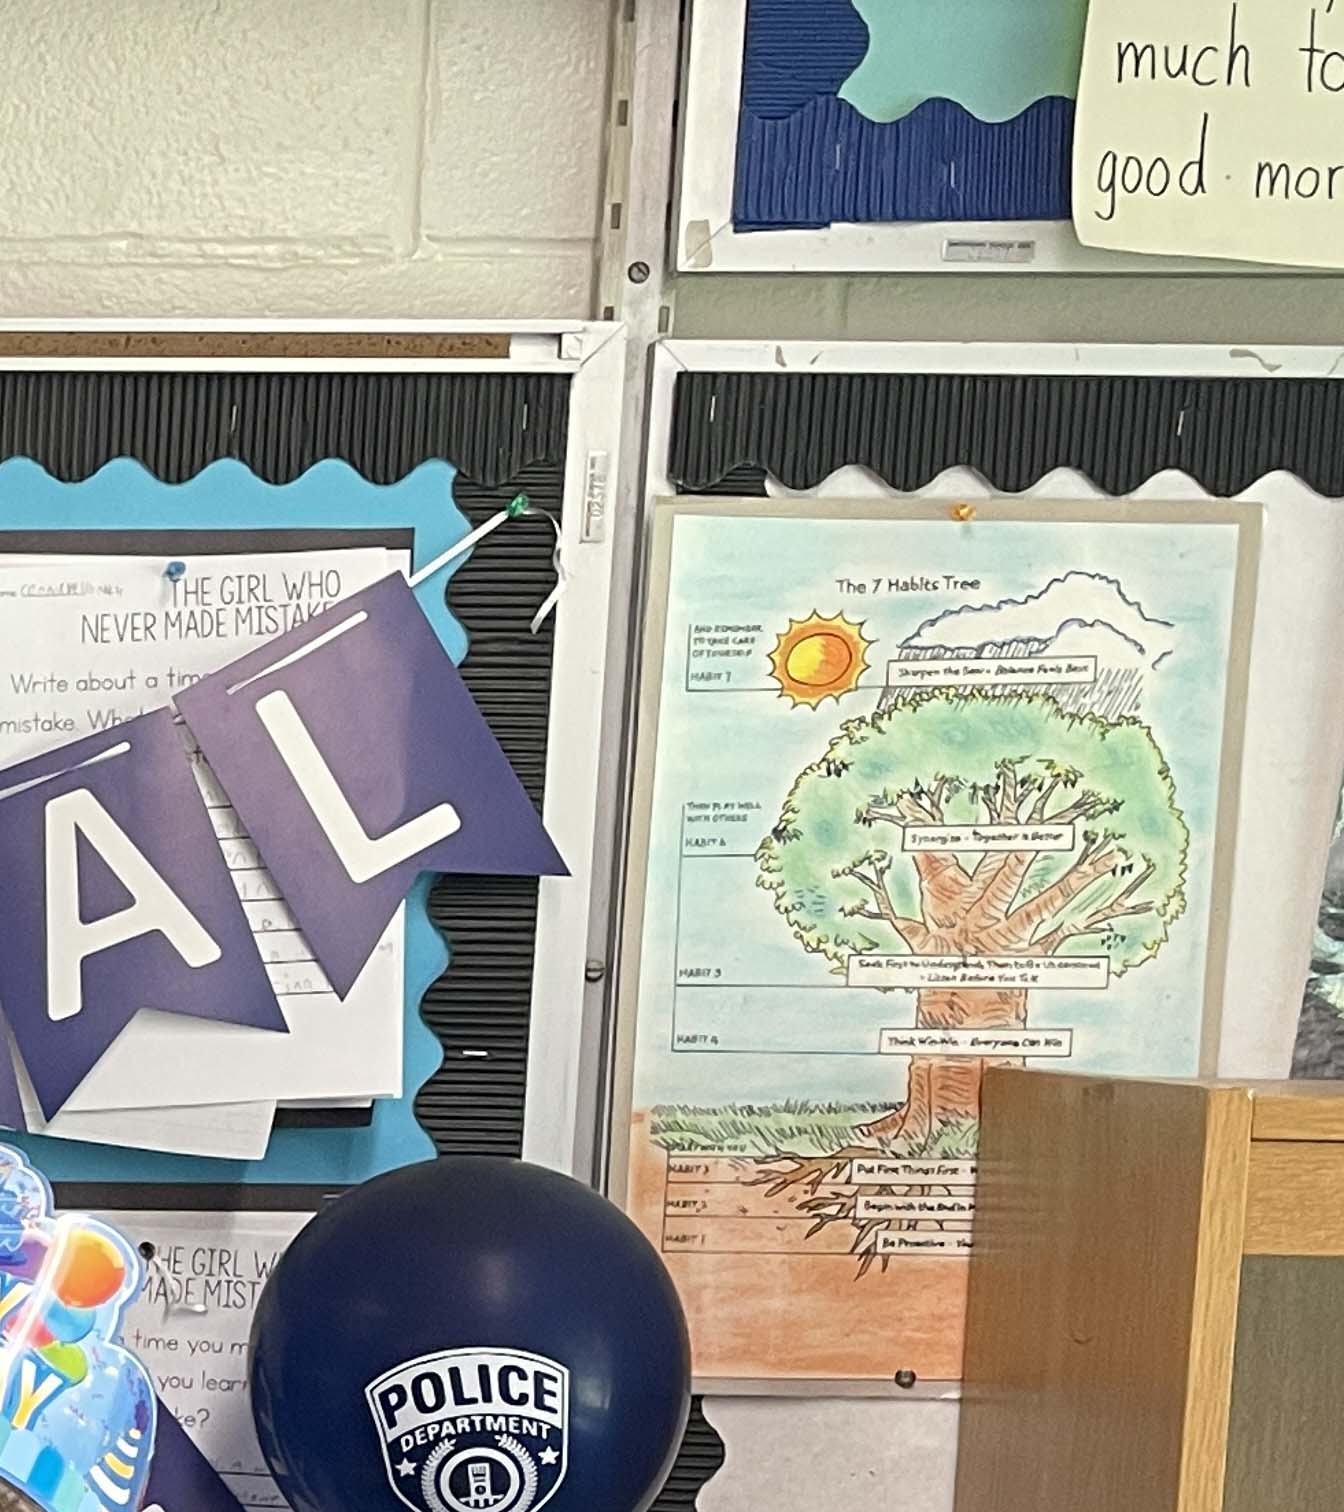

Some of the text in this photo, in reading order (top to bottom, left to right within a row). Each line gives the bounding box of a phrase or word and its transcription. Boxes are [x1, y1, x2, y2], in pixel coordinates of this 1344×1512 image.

[1118, 3, 1250, 87] much
[1097, 113, 1208, 219] good
[220, 573, 274, 606] GIRL
[283, 569, 342, 600] WHO
[835, 575, 981, 595] The 7 Habits Tree
[81, 607, 228, 644] NEVER MADE
[10, 669, 159, 695] Write about a
[0, 709, 80, 734] mistake.
[192, 1246, 245, 1279] GIRL
[132, 1328, 178, 1351] time
[187, 1340, 223, 1357] you
[157, 1374, 194, 1392] you
[378, 1363, 559, 1430] POLICE
[401, 1414, 552, 1453] DEPARTMENT
